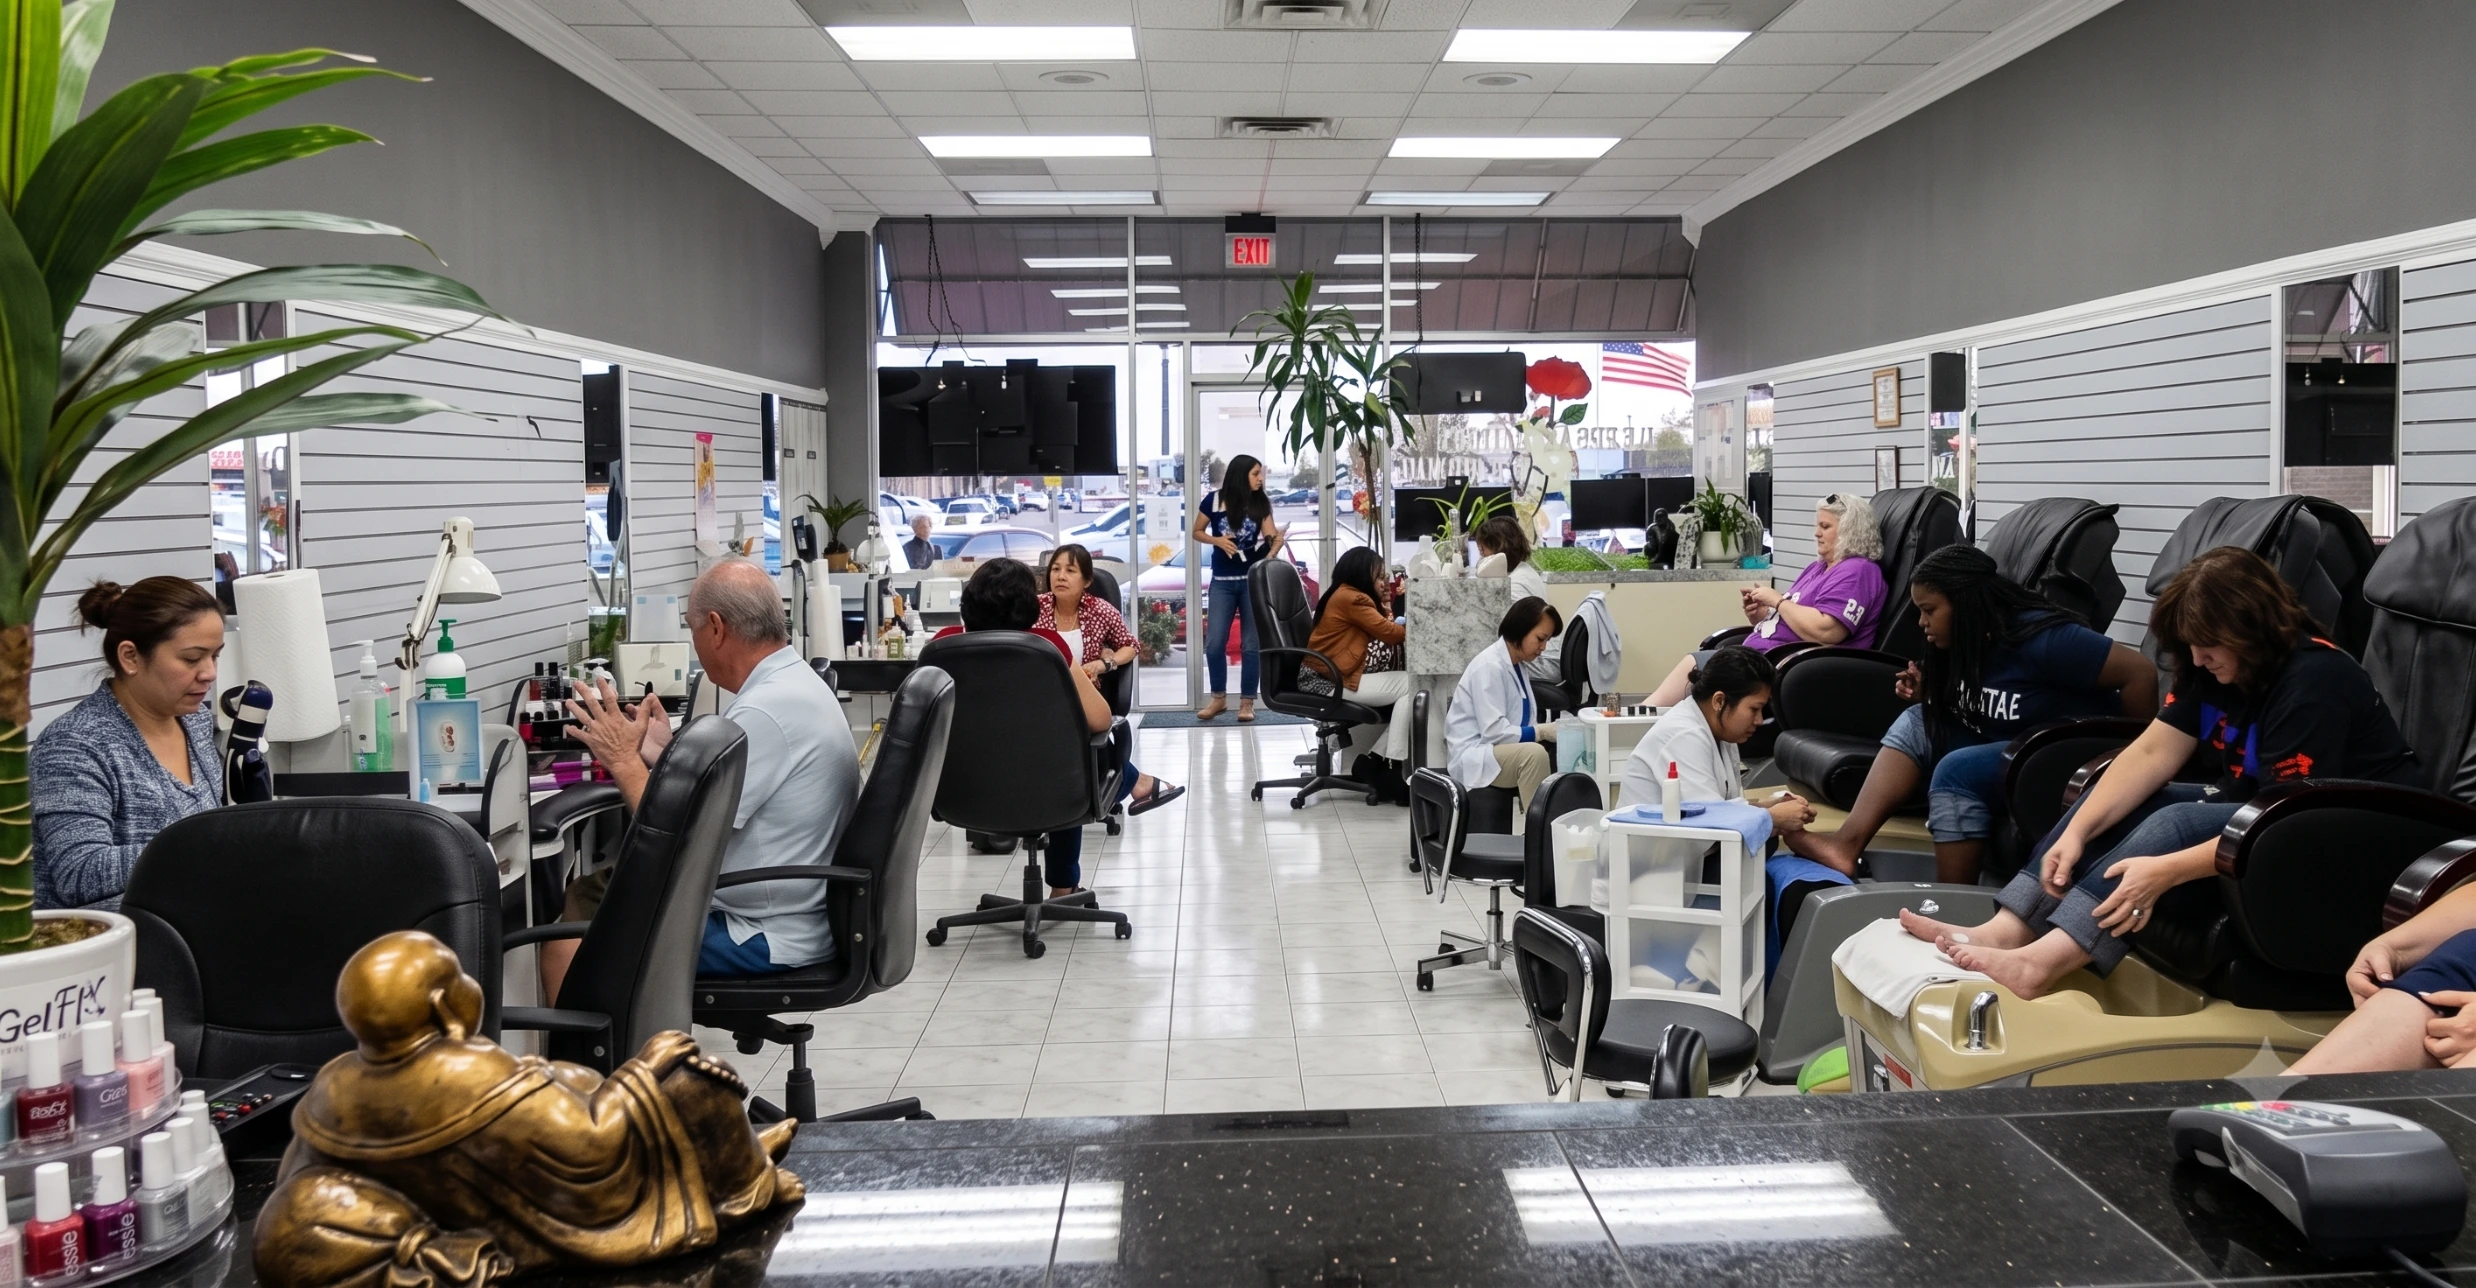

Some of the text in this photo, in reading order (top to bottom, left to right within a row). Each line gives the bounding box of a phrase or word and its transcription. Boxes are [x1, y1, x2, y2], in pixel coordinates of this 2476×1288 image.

[1234, 238, 1270, 264] EXIT
[62, 1230, 78, 1276] essie
[121, 1212, 135, 1259] essie
